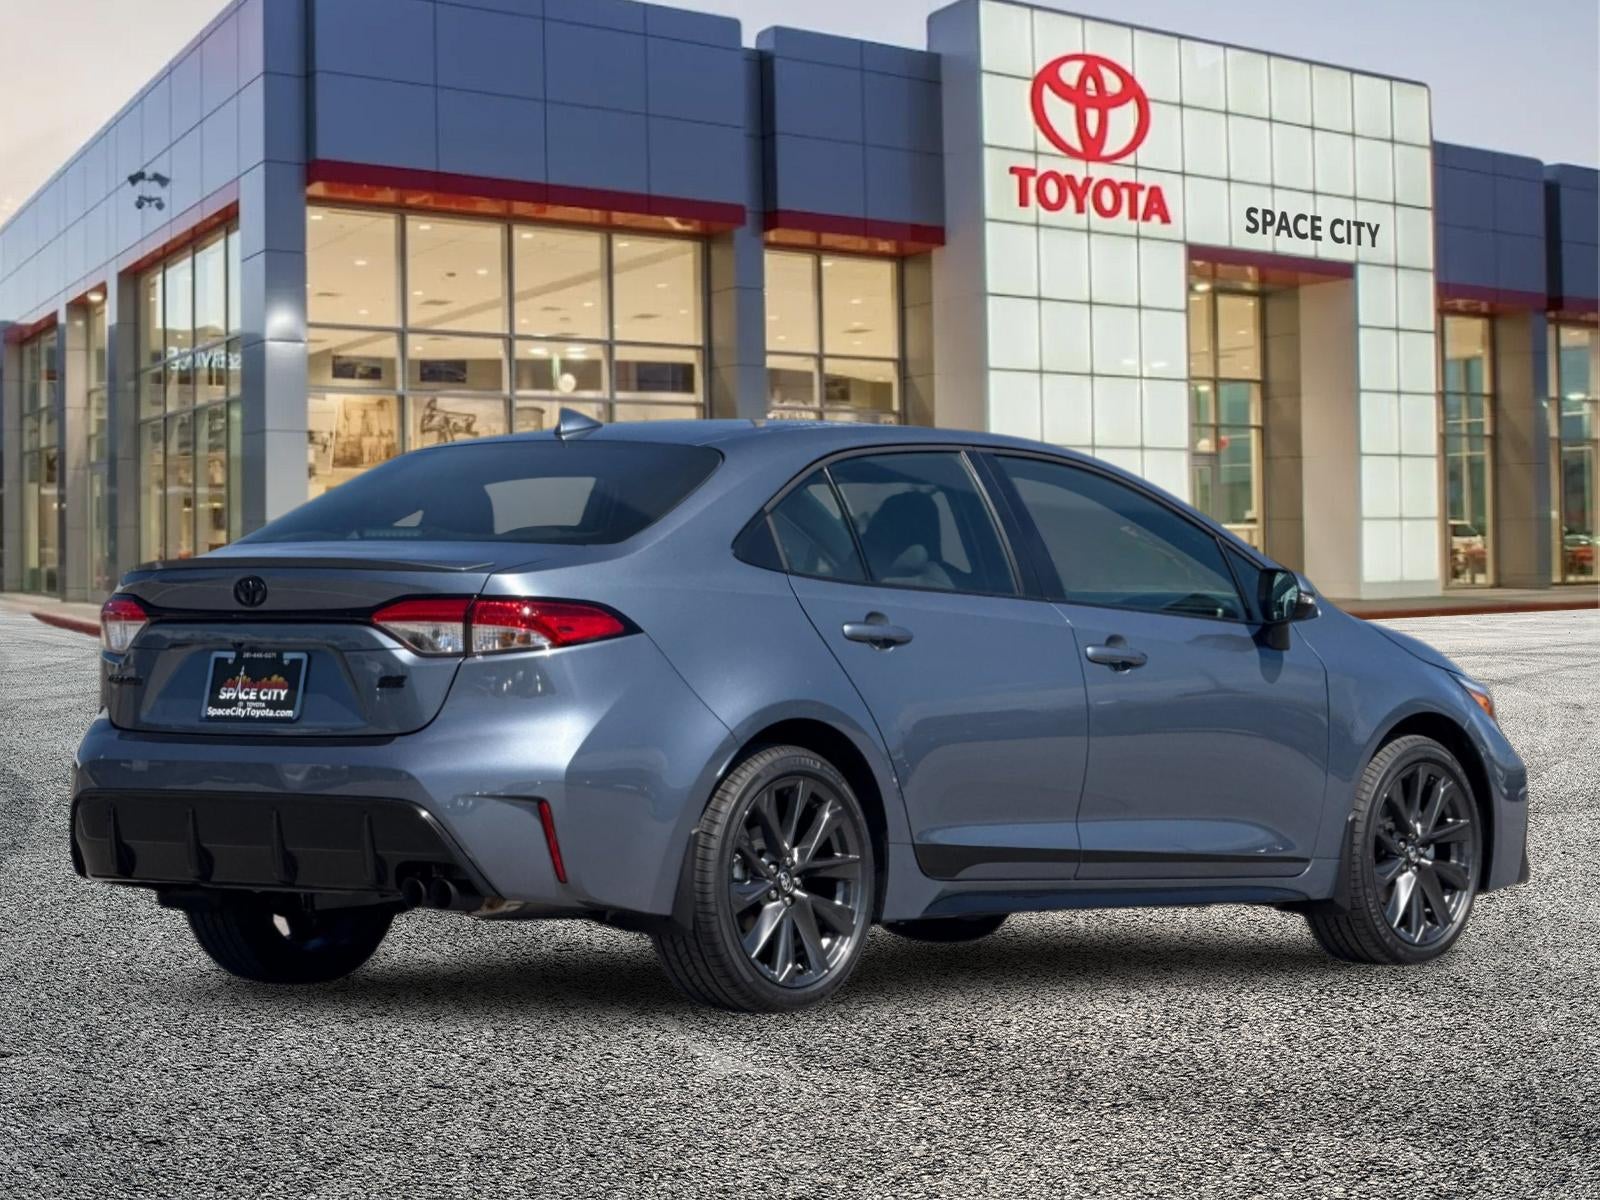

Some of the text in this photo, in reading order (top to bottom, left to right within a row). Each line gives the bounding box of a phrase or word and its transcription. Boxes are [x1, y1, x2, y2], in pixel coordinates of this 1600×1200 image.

[1009, 166, 1171, 224] TOYOTA
[1245, 207, 1380, 248] SPACE CITY
[218, 686, 288, 701] SPACE CITY
[207, 706, 294, 718] SpaceCityToyota.com
